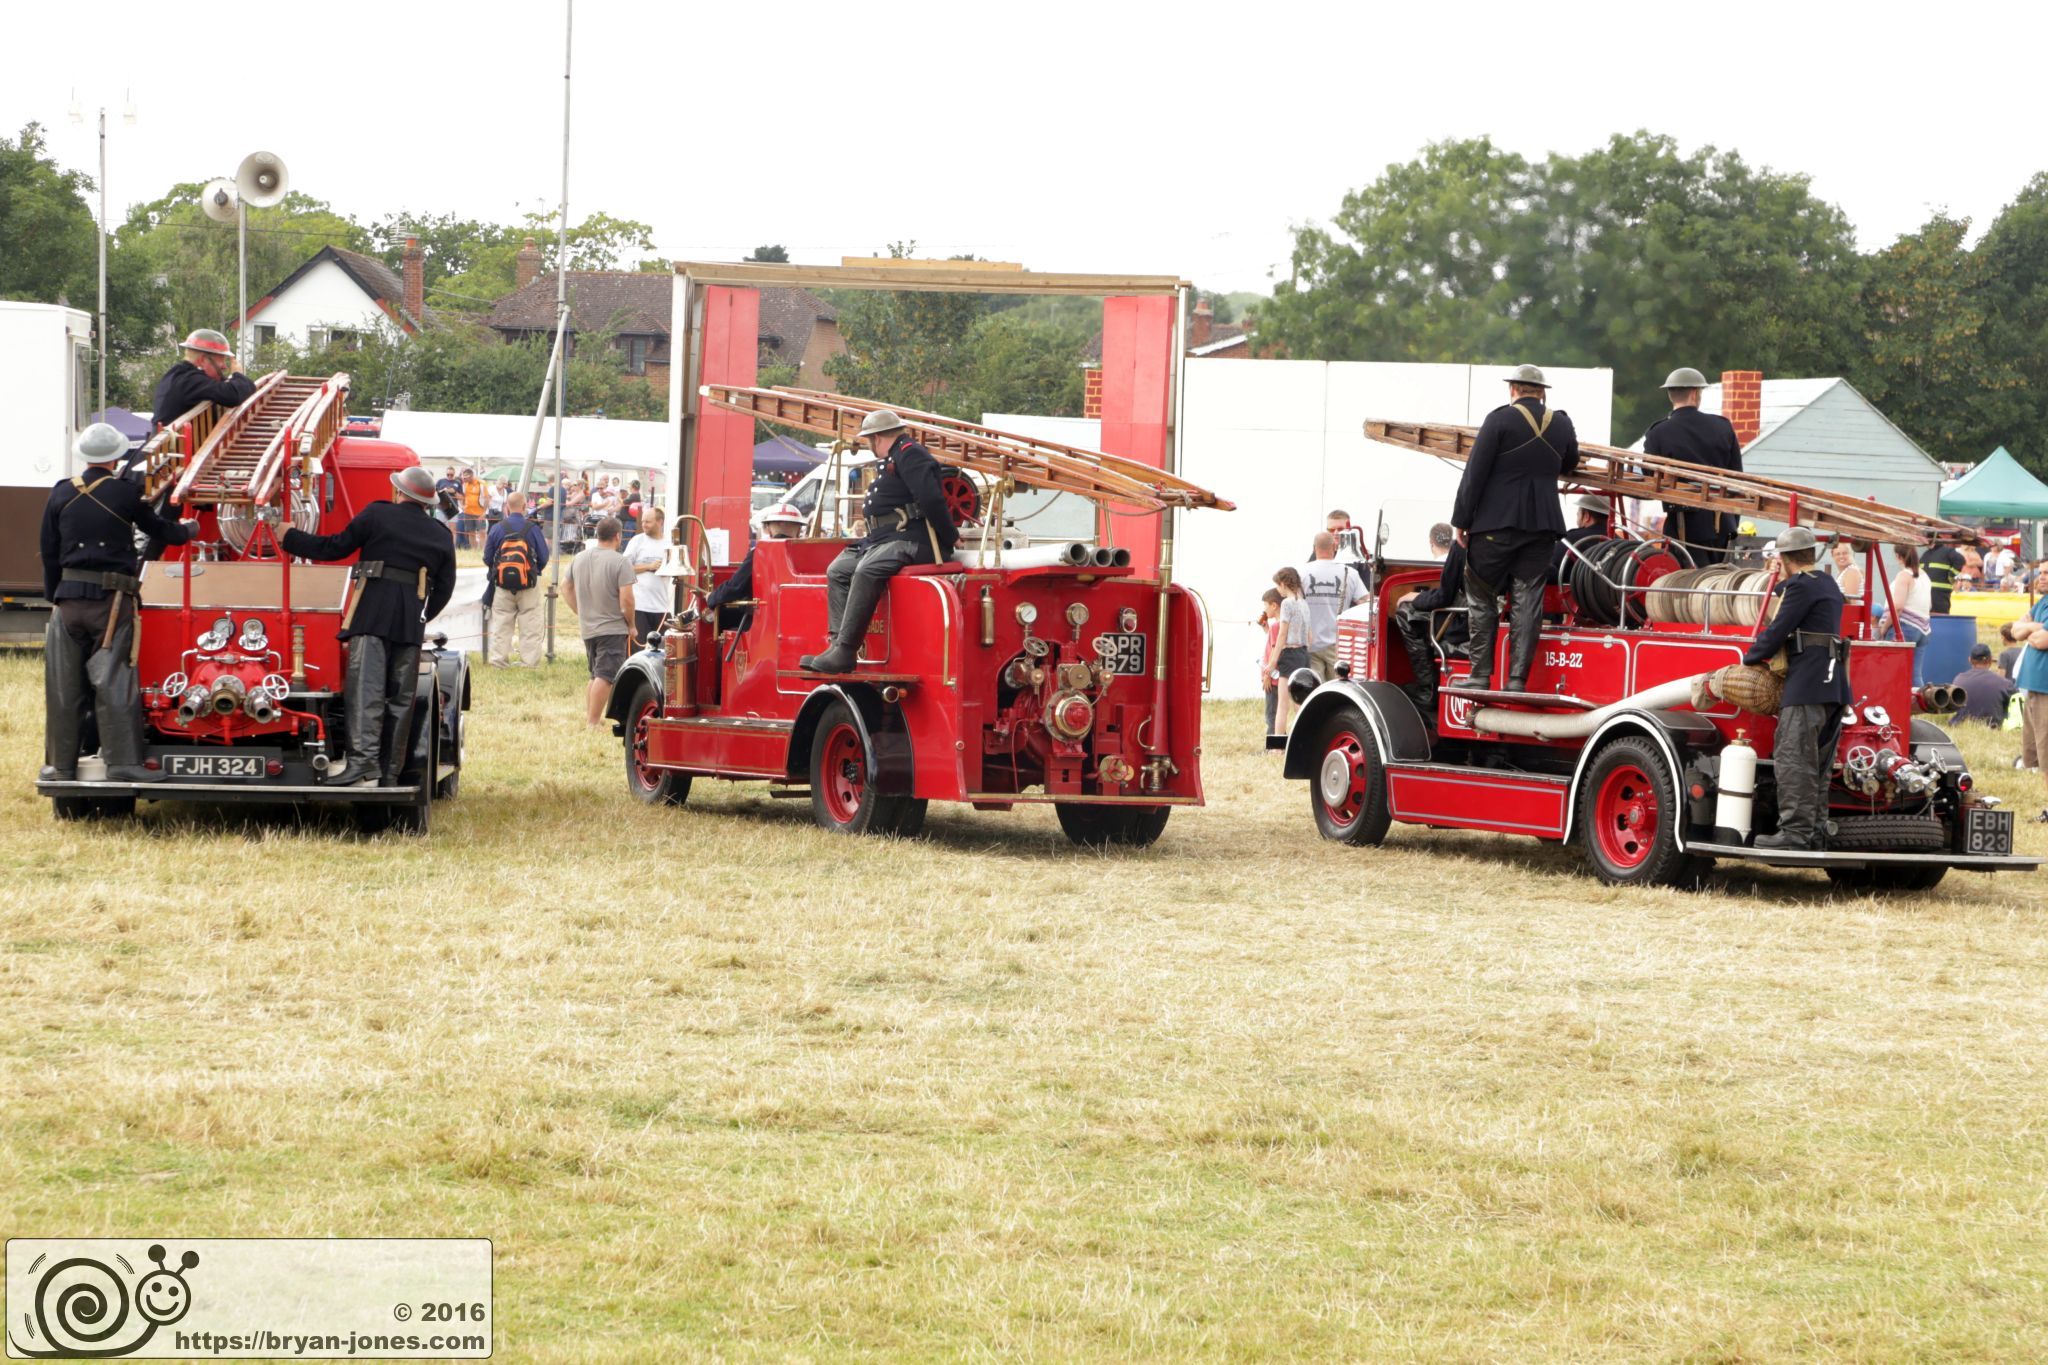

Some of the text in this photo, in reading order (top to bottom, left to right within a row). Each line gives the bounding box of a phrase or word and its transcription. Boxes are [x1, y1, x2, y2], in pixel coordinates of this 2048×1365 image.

[1104, 654, 1141, 672] 679
[172, 757, 257, 776] FJH 324
[1972, 811, 2009, 831] EBH
[1971, 832, 2008, 851] 823
